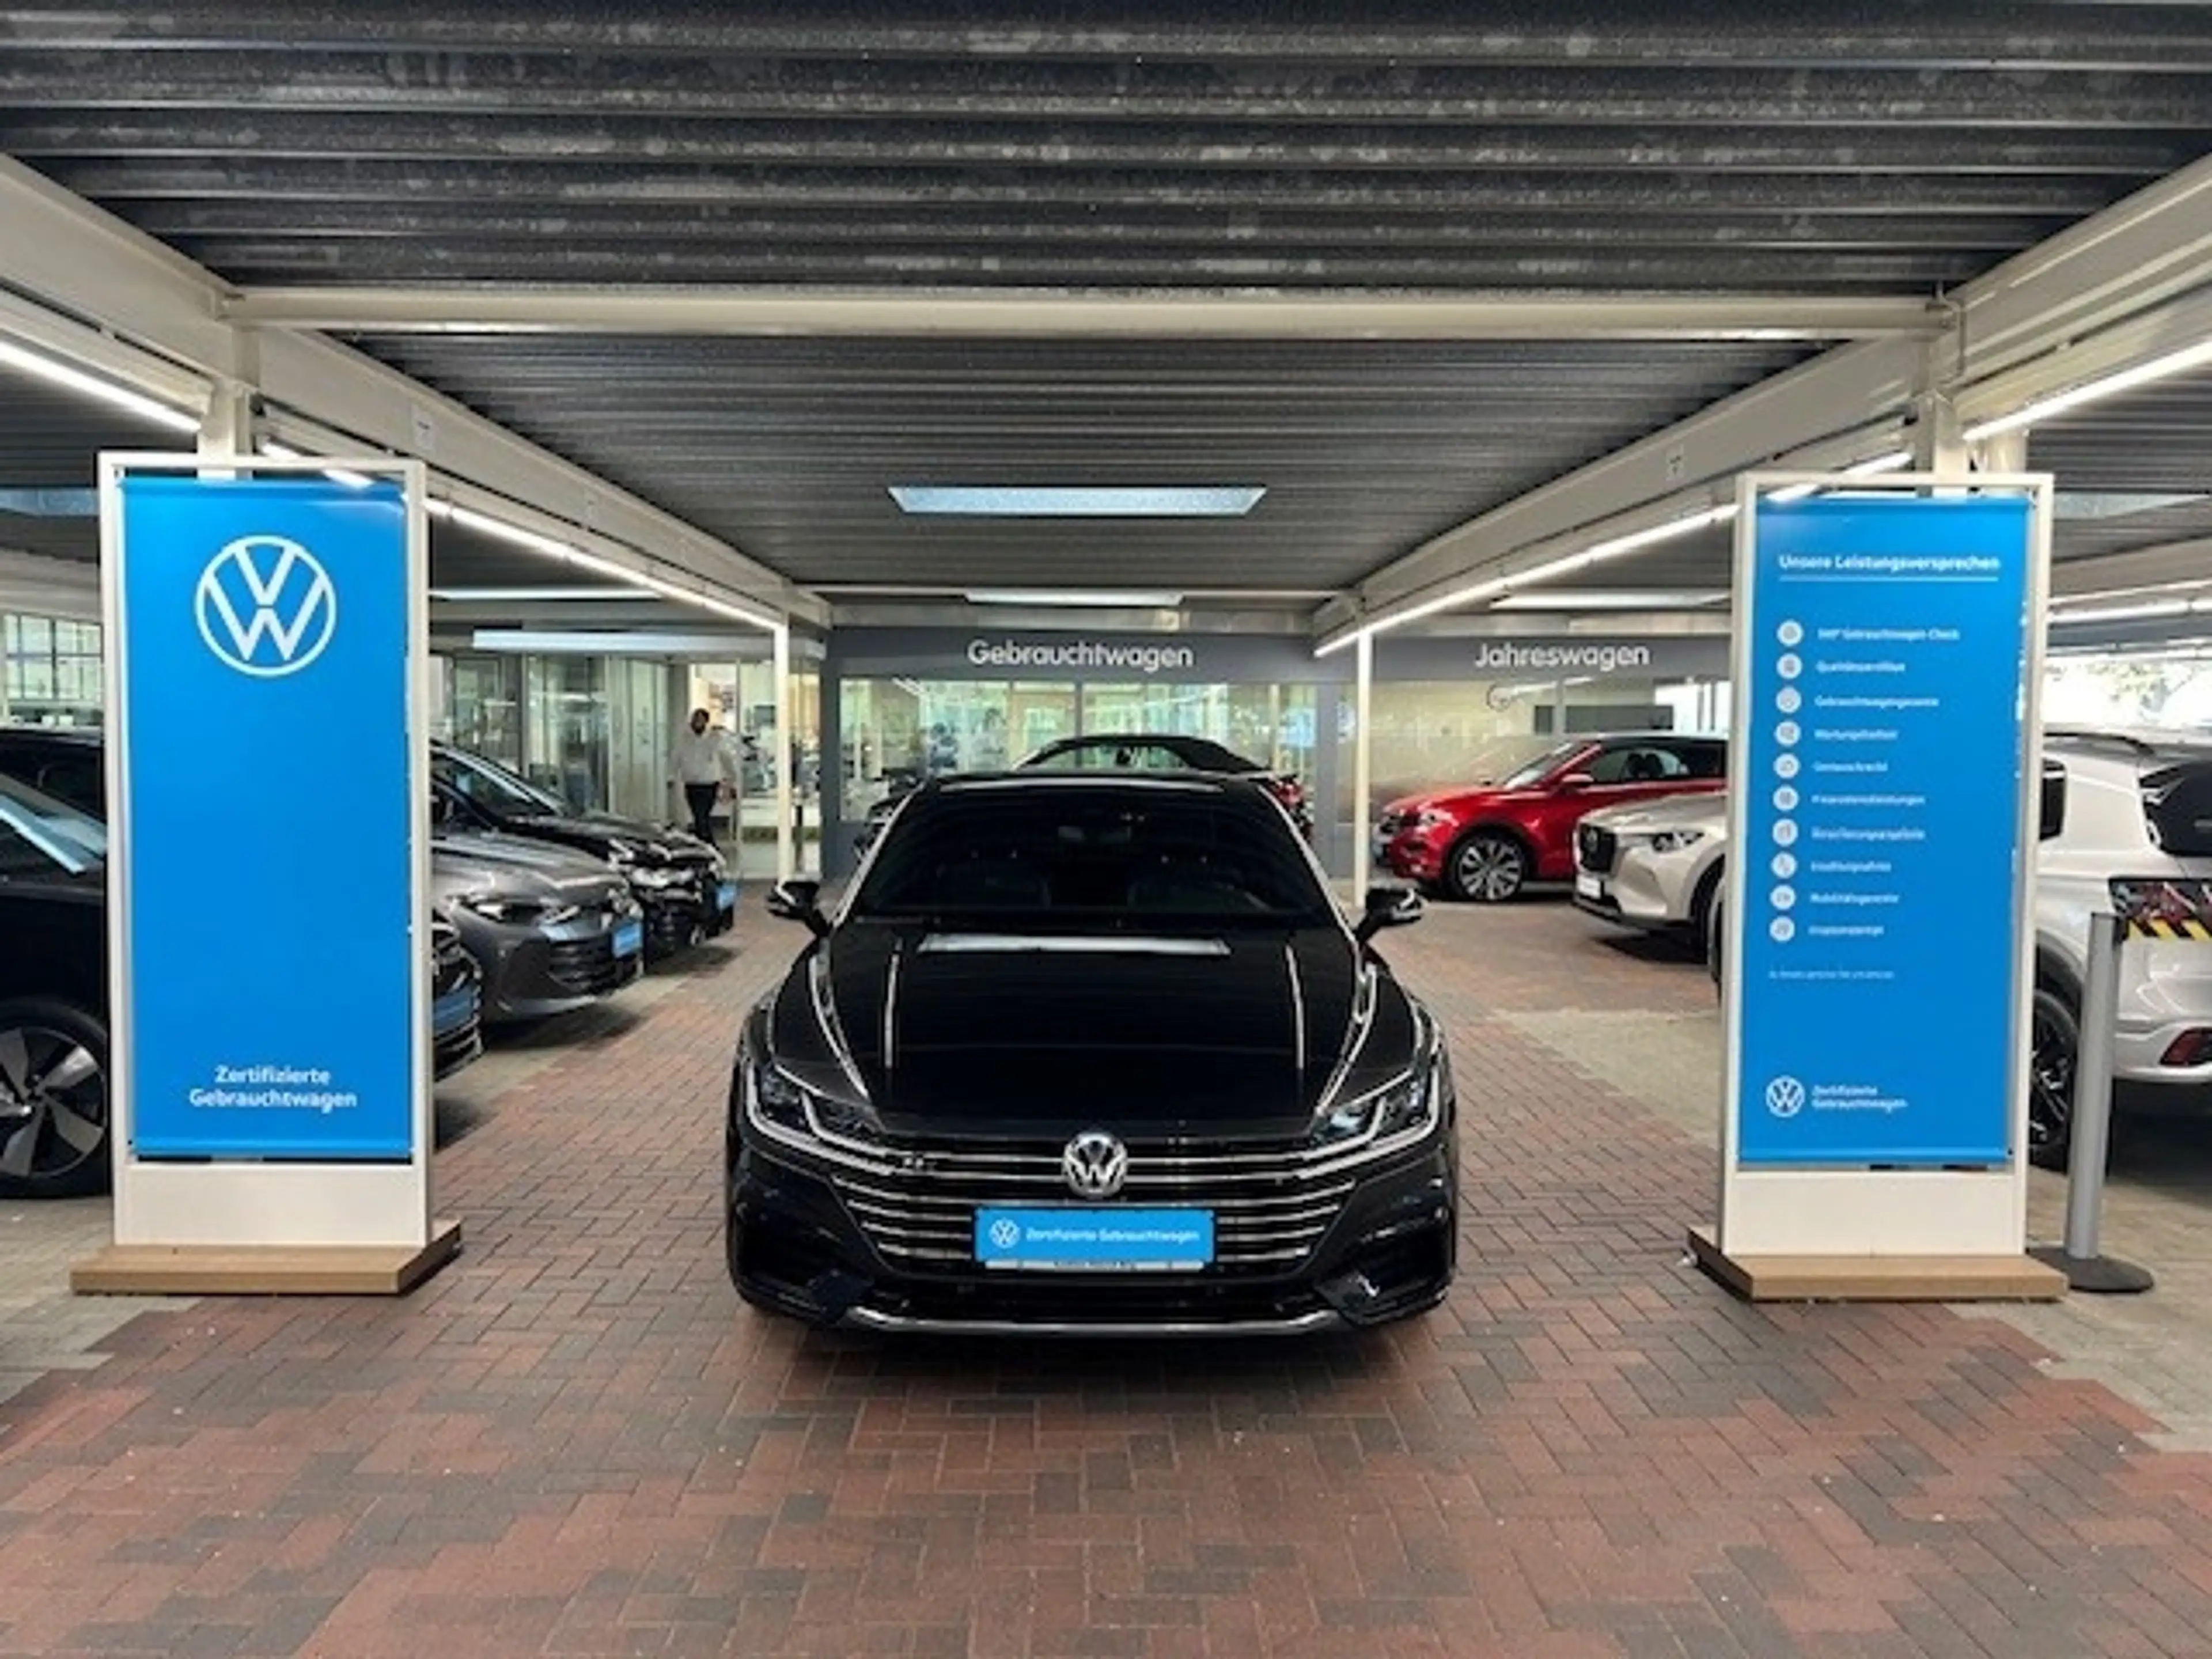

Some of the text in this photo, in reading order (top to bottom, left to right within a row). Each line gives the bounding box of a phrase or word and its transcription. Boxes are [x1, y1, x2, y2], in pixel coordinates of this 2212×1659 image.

[1778, 555, 1831, 571] Unsere
[967, 639, 1194, 673] Gebrauchtwagen
[1474, 643, 1650, 672] Jahreswagen
[214, 1065, 331, 1085] Zertifizierte
[189, 1088, 357, 1114] Gebrauchtwagen
